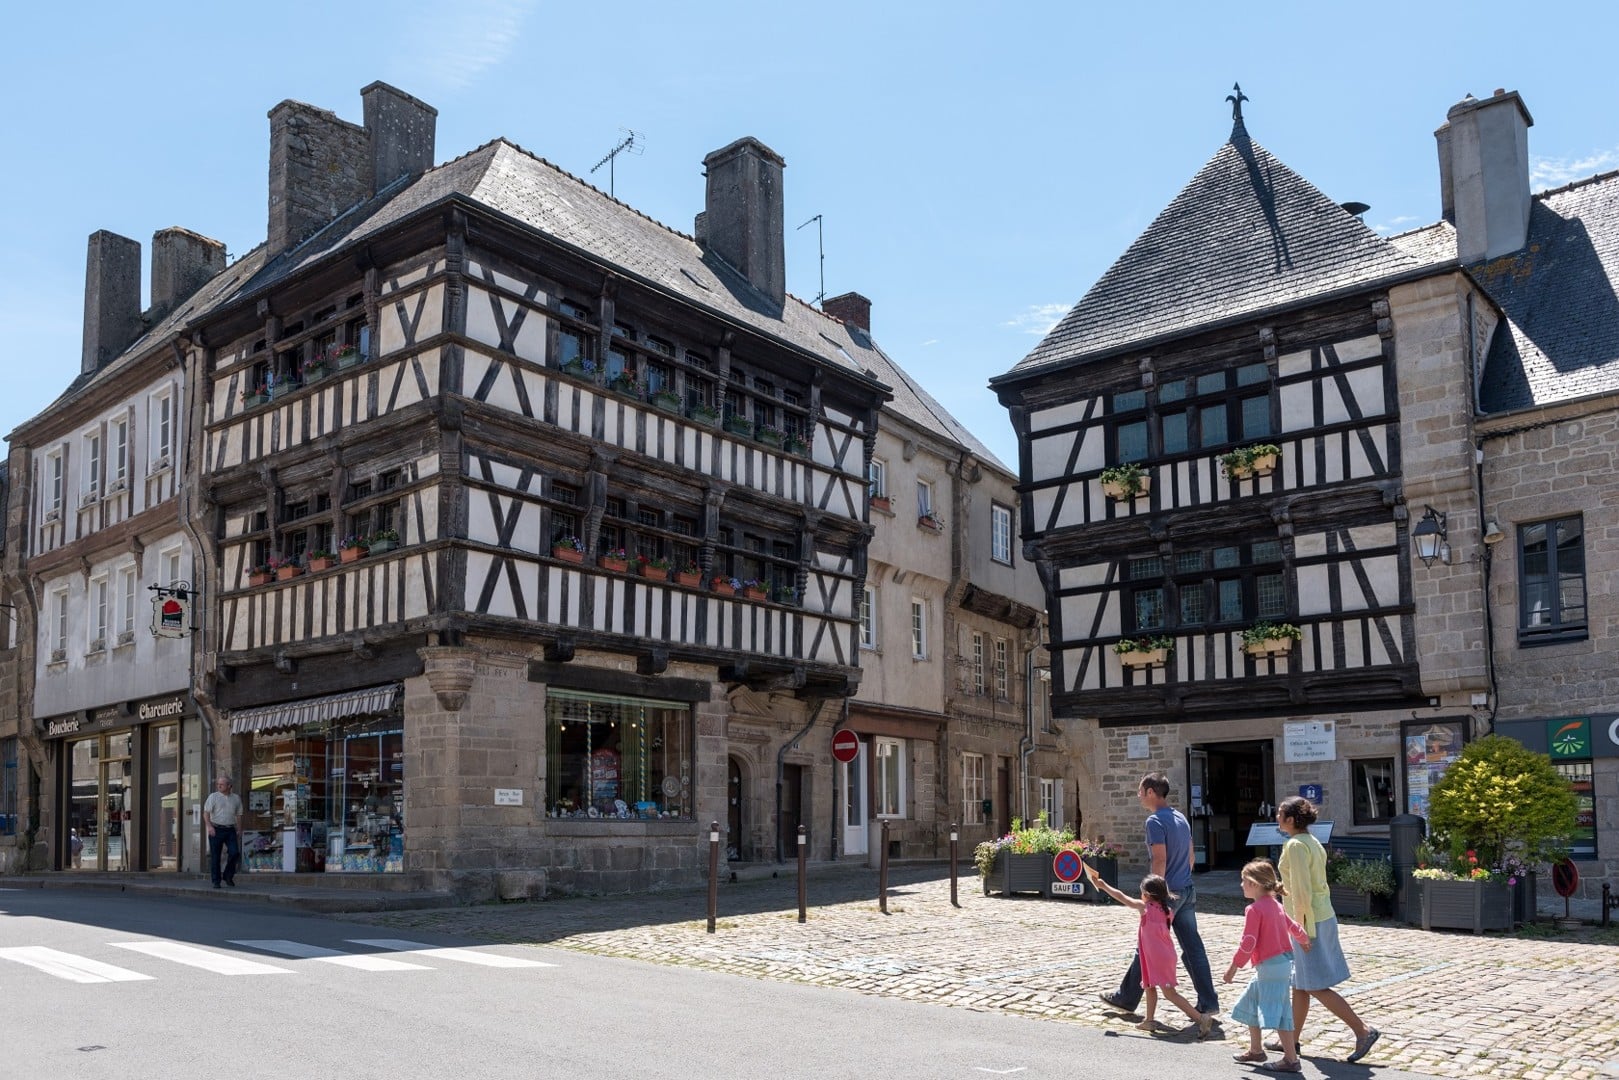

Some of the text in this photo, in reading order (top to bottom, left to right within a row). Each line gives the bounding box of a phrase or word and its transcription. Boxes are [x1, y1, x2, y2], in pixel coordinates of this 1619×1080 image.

[139, 697, 183, 720] Charcuterie
[49, 717, 80, 736] Boucherie
[1053, 884, 1071, 892] SAUF
